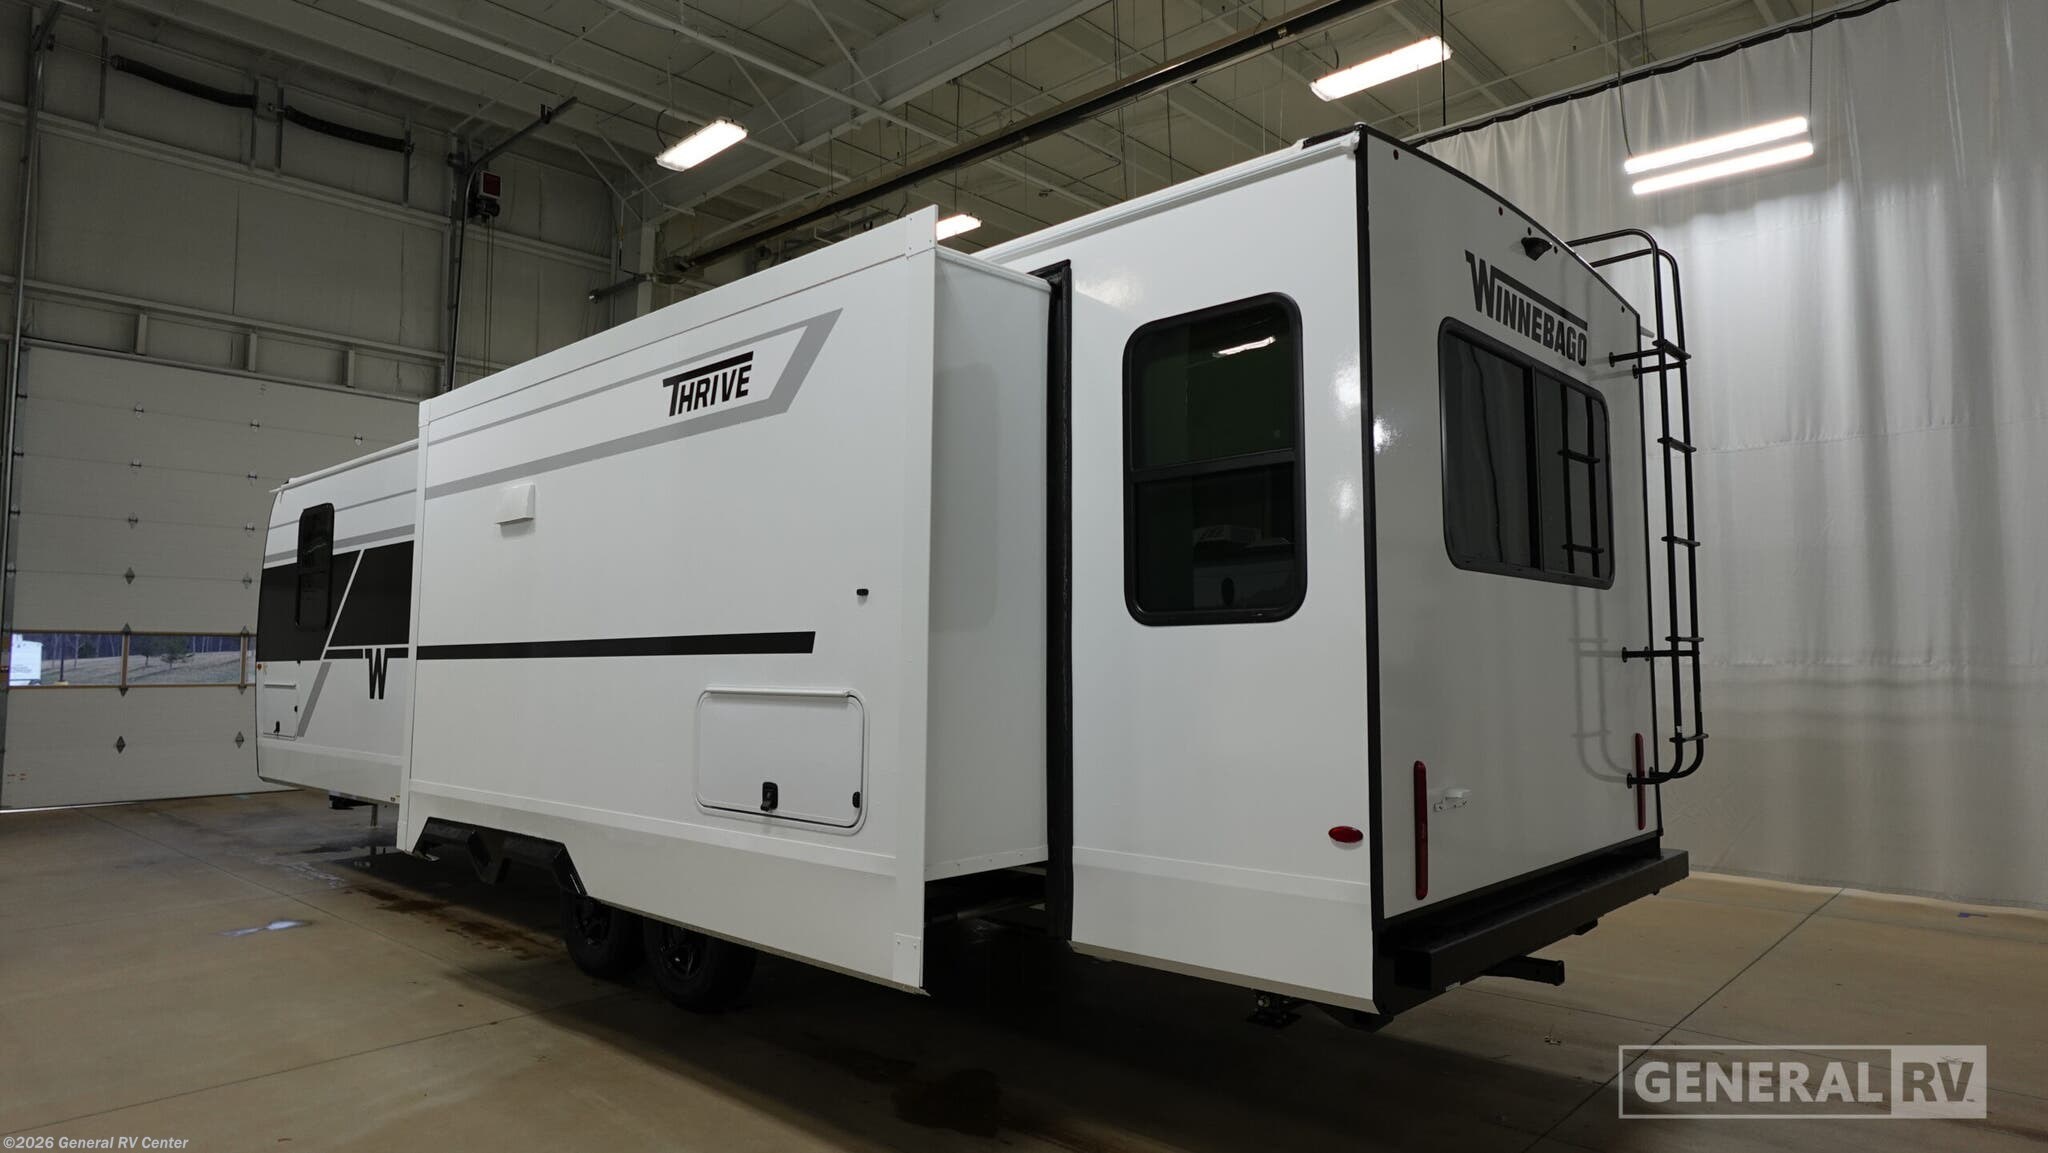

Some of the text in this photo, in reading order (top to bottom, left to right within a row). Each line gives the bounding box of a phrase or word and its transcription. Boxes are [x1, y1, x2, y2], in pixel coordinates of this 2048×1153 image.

[1464, 249, 1588, 367] WINNEBAGO
[662, 351, 754, 417] THRIVE
[365, 647, 395, 700] W
